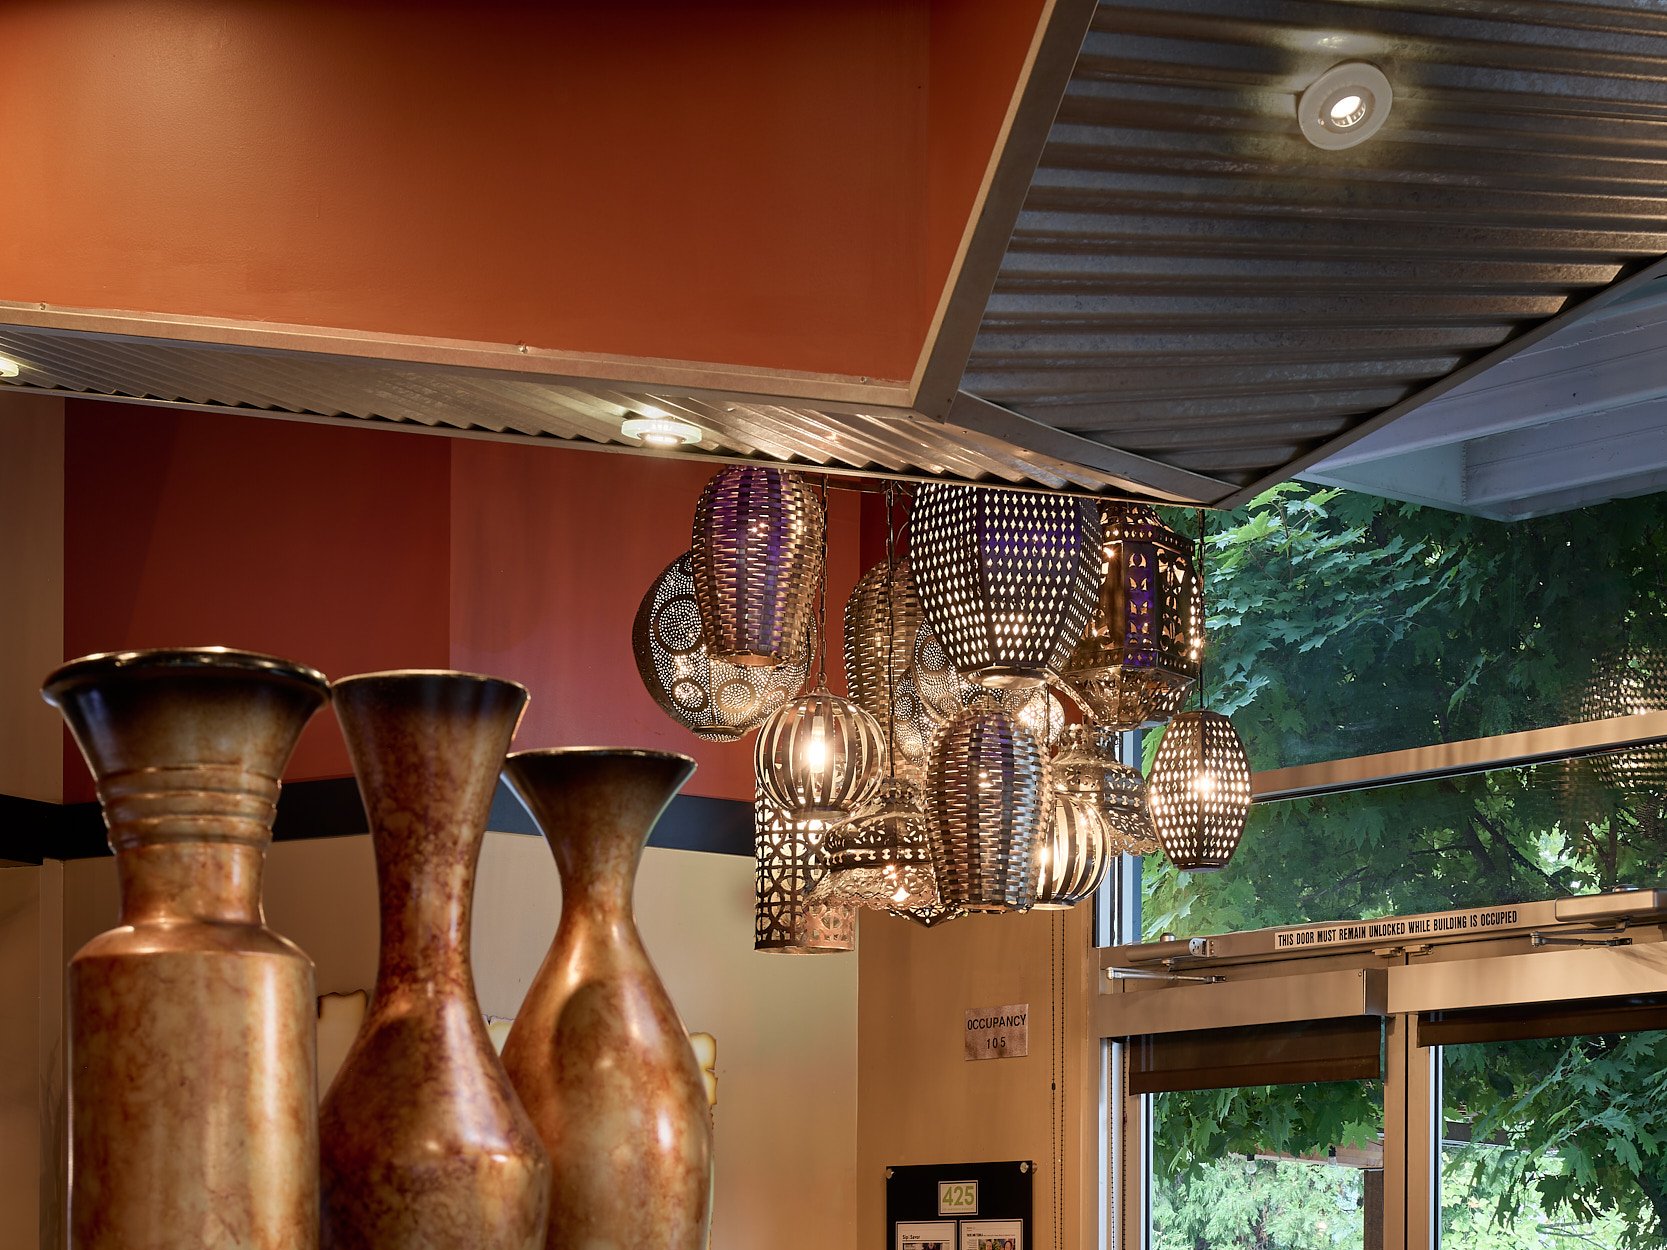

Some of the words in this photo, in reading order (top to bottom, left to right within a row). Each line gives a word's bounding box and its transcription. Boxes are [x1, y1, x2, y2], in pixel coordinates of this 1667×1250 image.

[1278, 933, 1294, 947] THIS
[1296, 931, 1314, 945] DOOR
[1317, 929, 1336, 943] MUST
[1339, 926, 1366, 941] REMAIN
[1369, 922, 1406, 938] UNLOCKED
[1408, 920, 1431, 935] WHILE
[1433, 915, 1467, 932] BUILDING
[1470, 914, 1478, 927] IS
[1480, 910, 1517, 927] OCCUPIED
[967, 1014, 1027, 1030] OCCUPANCY
[942, 1185, 975, 1206] 425
